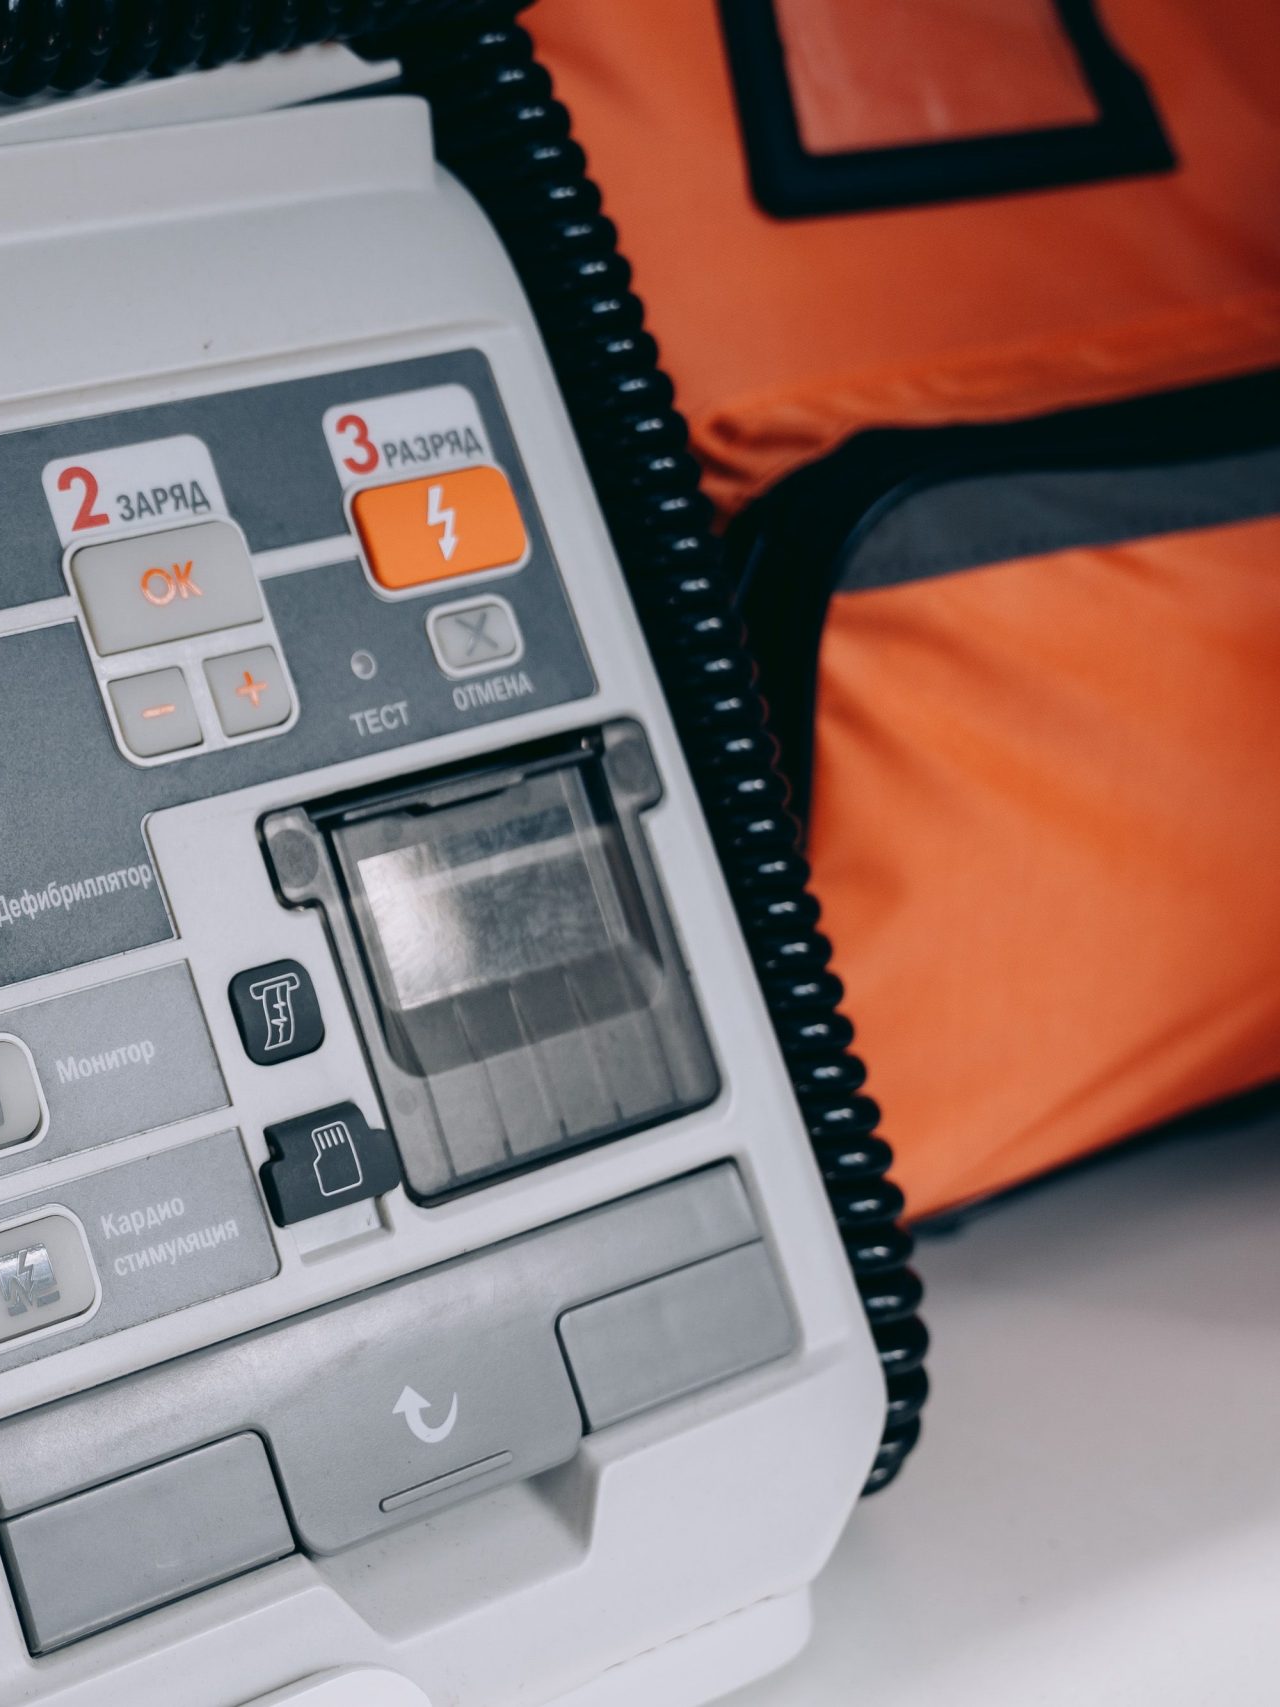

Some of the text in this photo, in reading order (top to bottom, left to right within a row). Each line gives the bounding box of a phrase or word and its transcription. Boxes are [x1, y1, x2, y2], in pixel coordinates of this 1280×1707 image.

[335, 414, 482, 474] 3 РАЗРЯД
[57, 466, 211, 531] 2 ЗАРЯД
[140, 560, 204, 607] OK
[452, 672, 533, 712] ОТМЕНА
[349, 701, 410, 737] ТЕСТ
[55, 1038, 157, 1084] Монитор
[101, 1196, 186, 1240] Кардио
[114, 1219, 240, 1277] стимуляция
